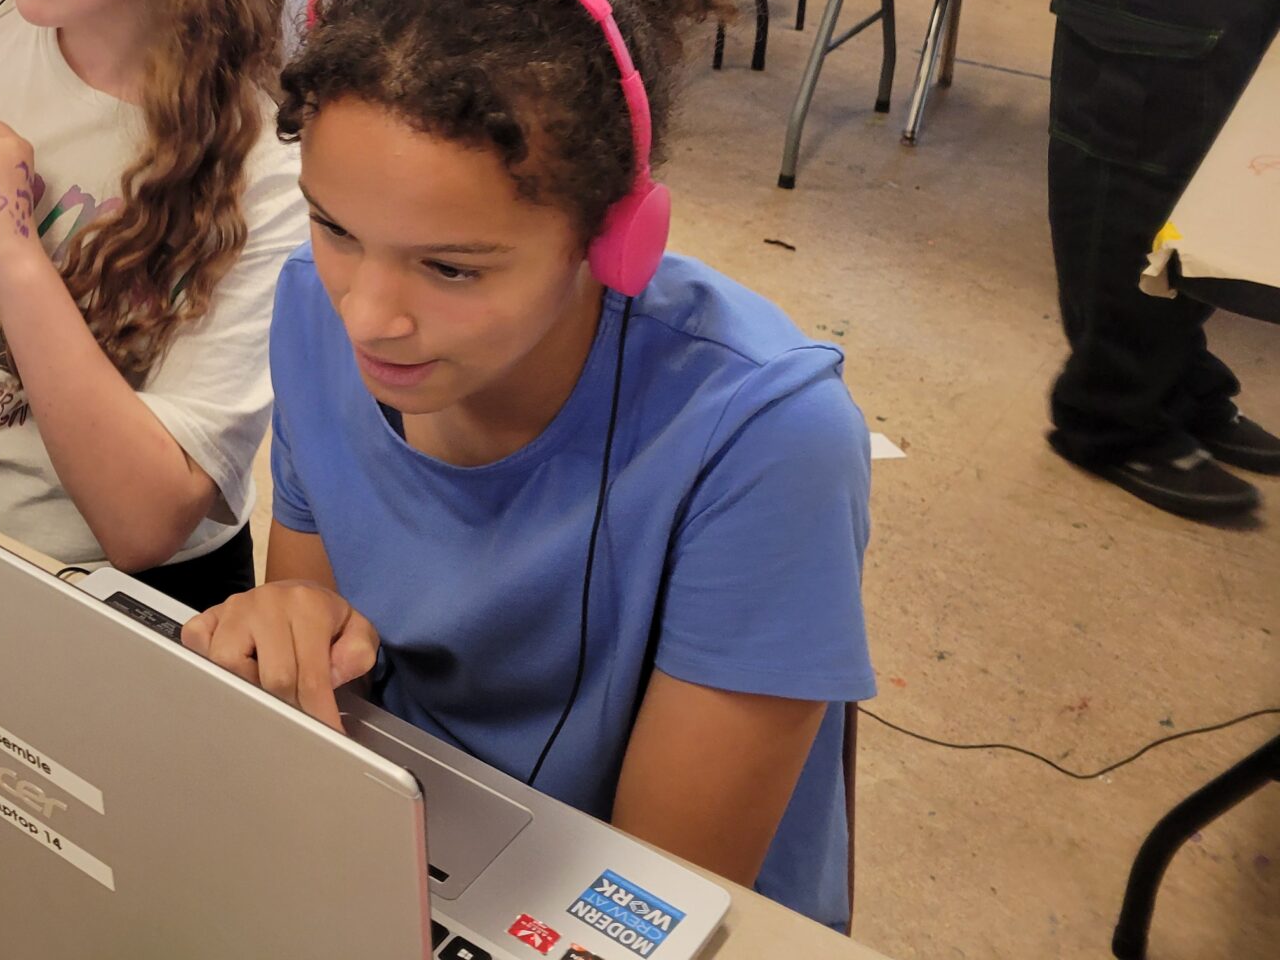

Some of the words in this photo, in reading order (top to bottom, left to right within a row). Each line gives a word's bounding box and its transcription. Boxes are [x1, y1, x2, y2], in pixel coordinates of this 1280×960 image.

[44, 830, 62, 850] 14
[586, 893, 609, 907] AT
[571, 900, 655, 955] MODERN
[606, 906, 662, 940] CREW
